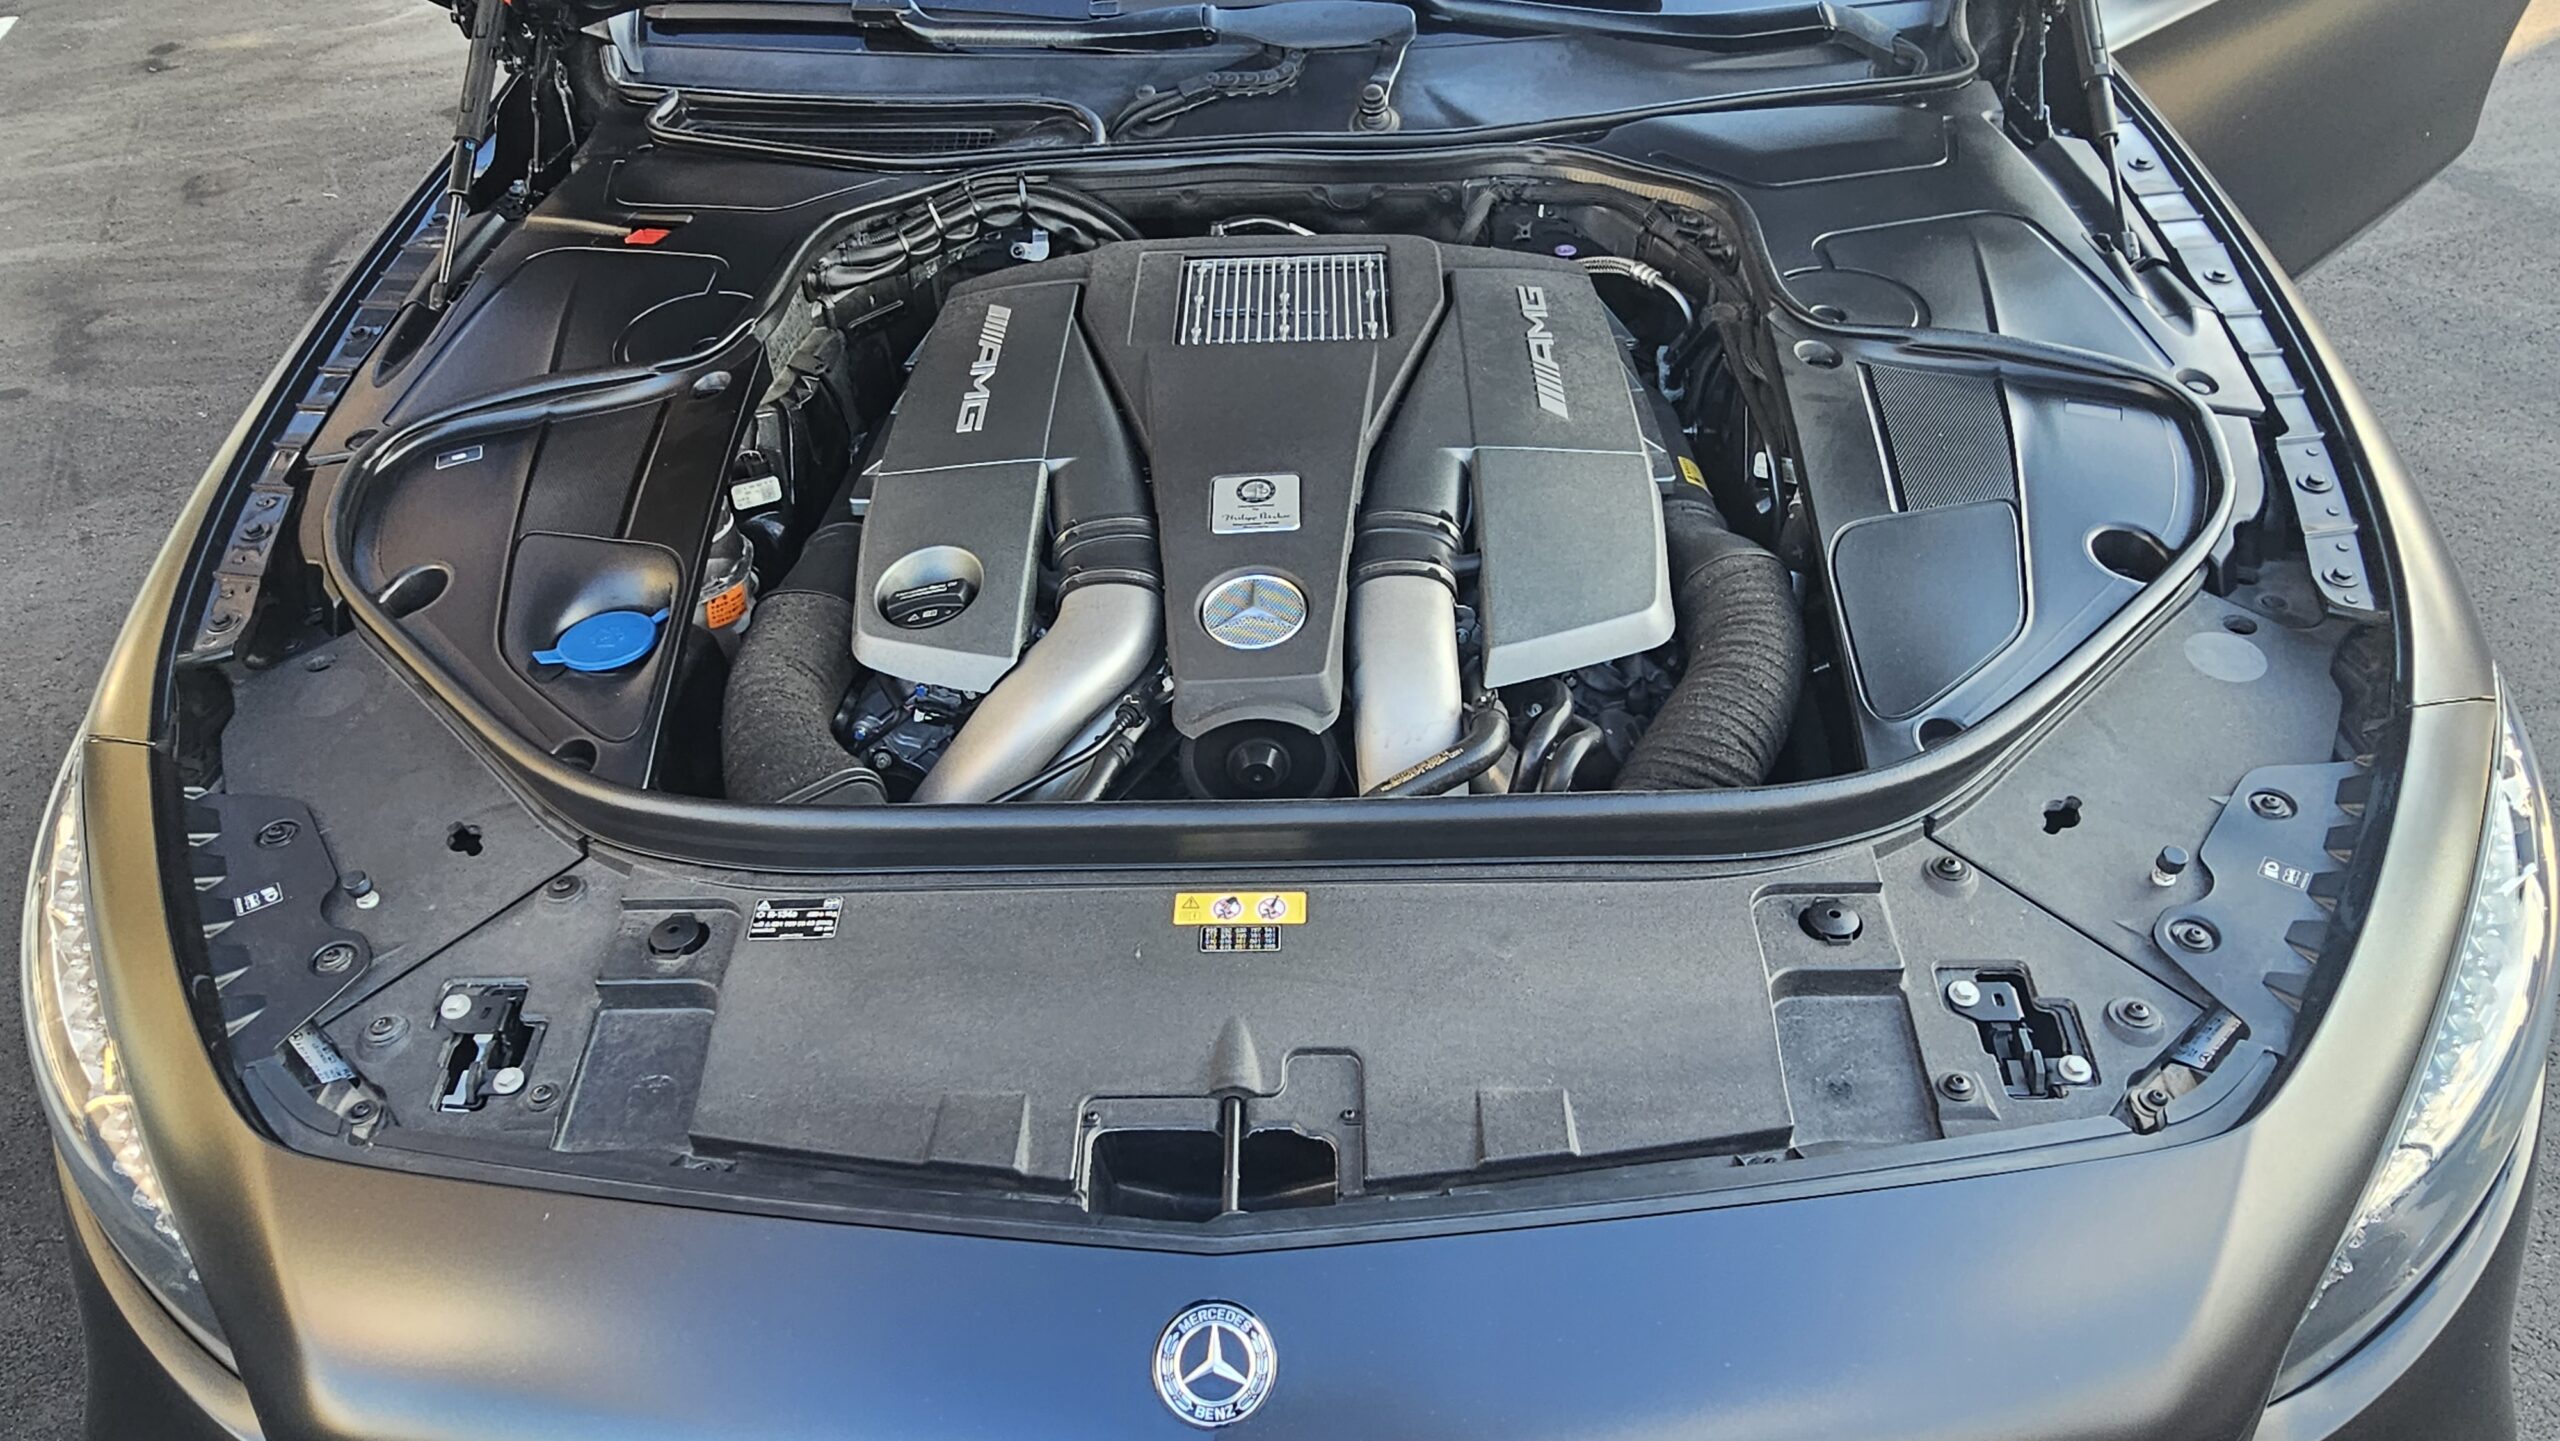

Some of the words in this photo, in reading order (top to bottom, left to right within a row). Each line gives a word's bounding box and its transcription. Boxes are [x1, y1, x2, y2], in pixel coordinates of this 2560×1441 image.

[1516, 285, 1560, 371] AMG
[956, 338, 1004, 433] AMG
[1178, 1308, 1252, 1333] MERCEDES
[1194, 1404, 1236, 1421] BENZ
